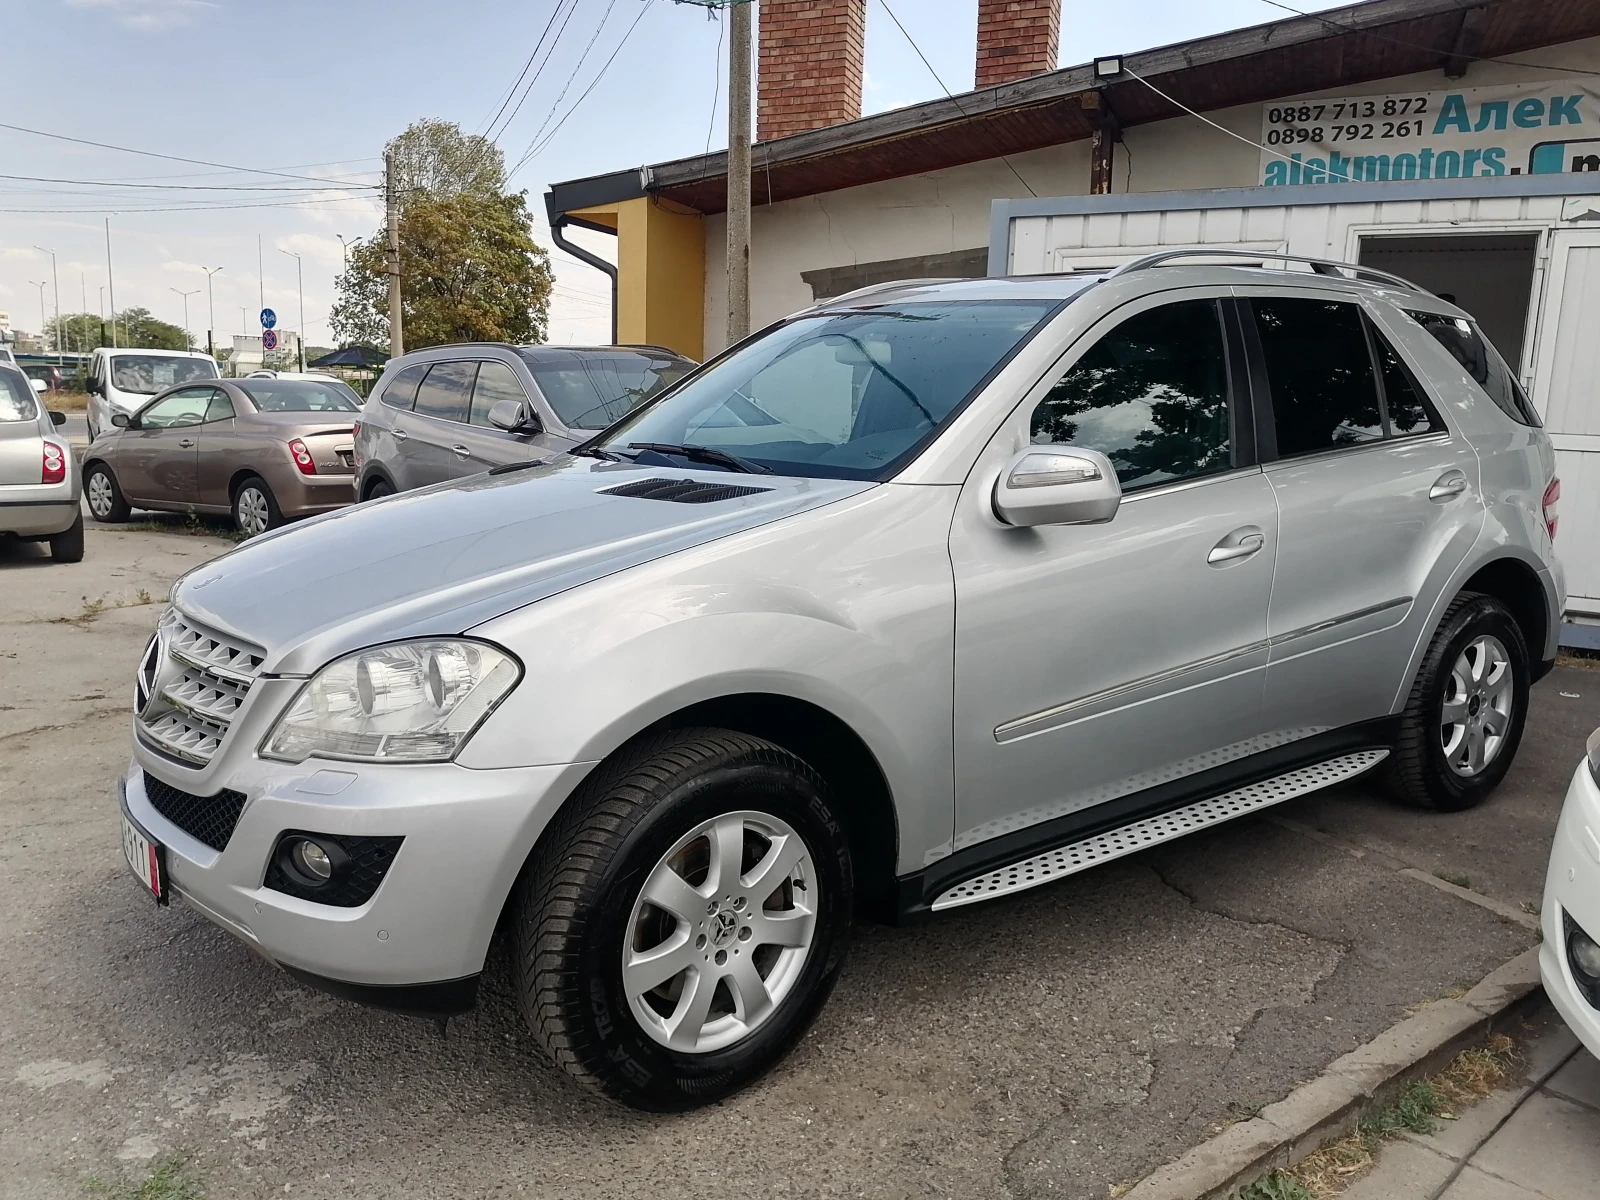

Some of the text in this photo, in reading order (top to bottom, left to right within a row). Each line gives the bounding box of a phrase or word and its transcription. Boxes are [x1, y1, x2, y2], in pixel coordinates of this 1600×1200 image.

[1268, 97, 1428, 124] 0887 713 872
[1432, 94, 1585, 135] Алек
[1267, 119, 1424, 146] 0898 792 261
